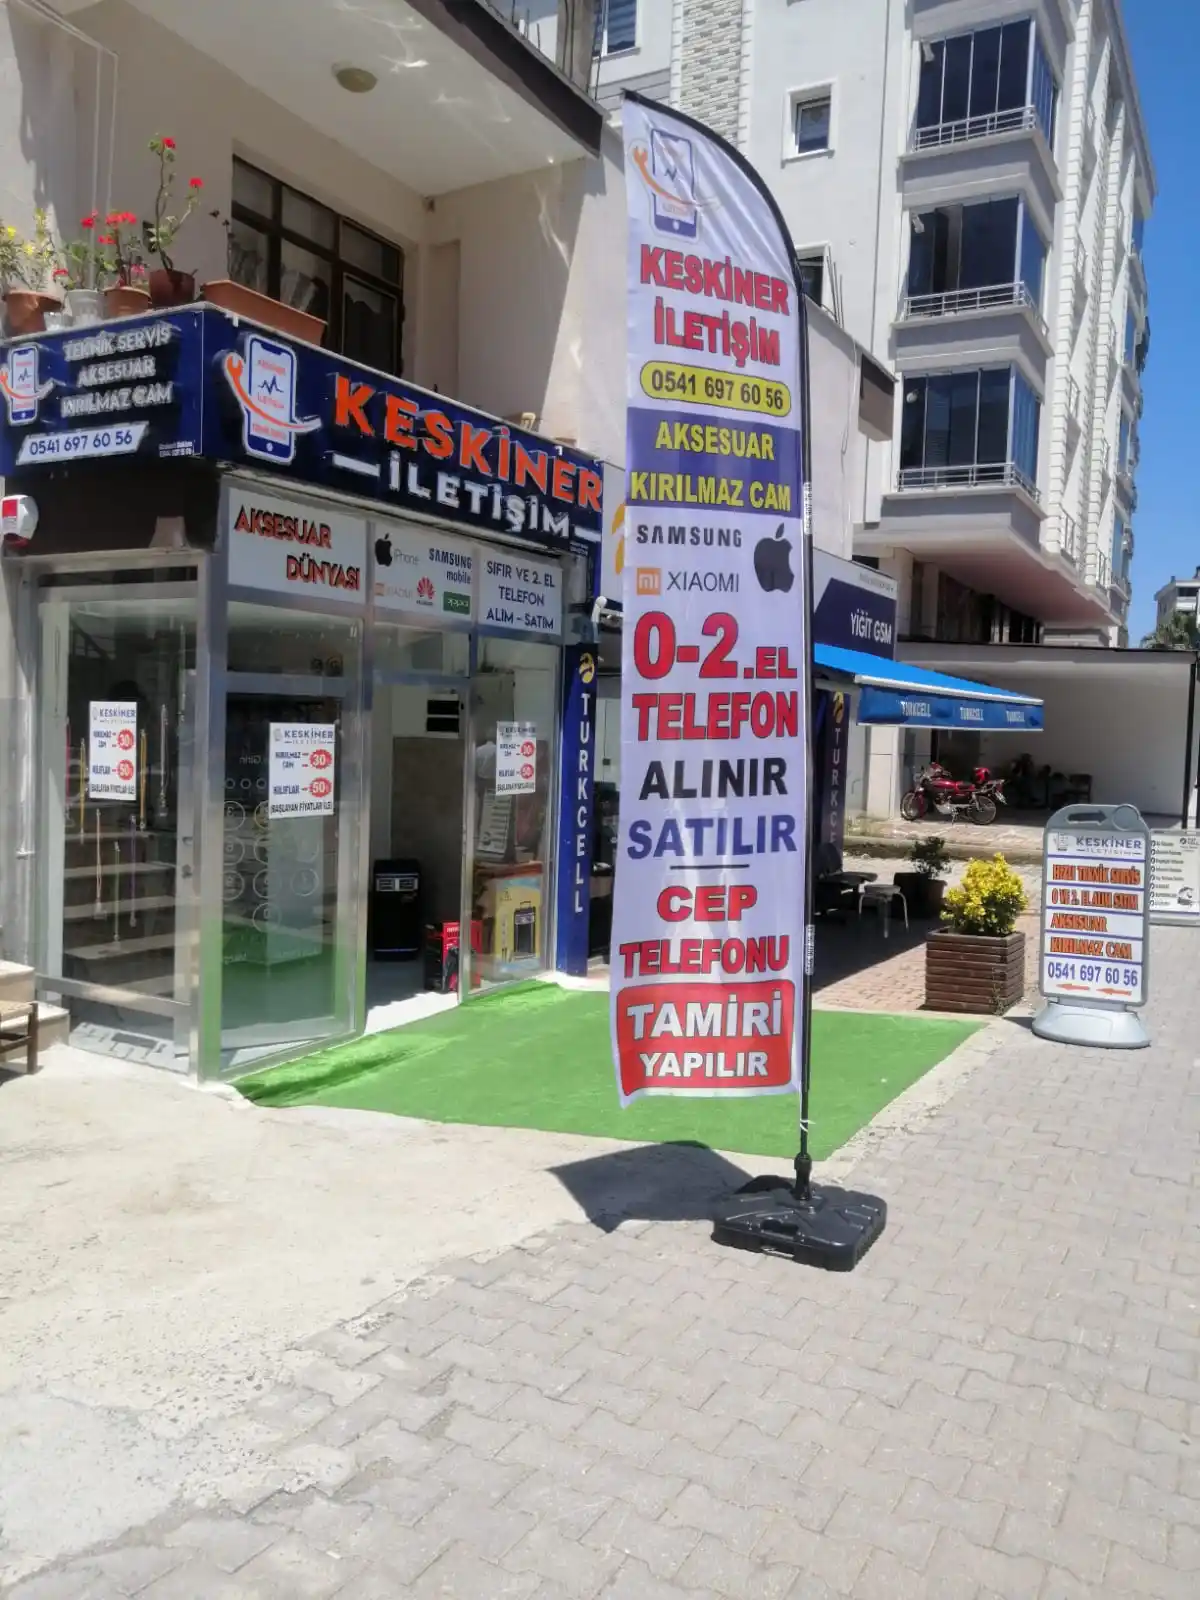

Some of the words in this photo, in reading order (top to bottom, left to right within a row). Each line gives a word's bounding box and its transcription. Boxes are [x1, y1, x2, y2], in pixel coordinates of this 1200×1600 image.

[640, 243, 790, 316] KESKİNER
[654, 295, 781, 368] İLETİŞİM
[77, 355, 156, 387] AKSESUAR
[651, 369, 696, 395] 0541
[704, 376, 735, 400] 697
[740, 383, 761, 405] 60
[766, 387, 784, 410] 56
[132, 381, 173, 408] CAM
[29, 439, 60, 455] 0541
[63, 435, 88, 451] 697
[93, 432, 111, 448] 60
[115, 430, 133, 445] 56
[333, 374, 602, 513] KESKİNER
[655, 420, 775, 460] AKSESUAR
[388, 450, 570, 539] İLETİŞİM
[630, 471, 745, 507] KIRILMAZ
[750, 481, 792, 512] CAM
[234, 505, 332, 549] AKSESUAR
[636, 524, 742, 548] SAMSUNG
[286, 552, 361, 591] DÜNYASI
[429, 548, 472, 569] SAMSUNG
[446, 570, 471, 584] mobile
[487, 560, 512, 579] SIFIR
[516, 567, 530, 582] VE
[544, 574, 556, 588] EL
[498, 585, 545, 607] TELEFON
[667, 571, 739, 592] XIAOMI
[486, 608, 514, 624] ALIM
[525, 614, 554, 629] SATIM
[850, 608, 873, 637] YİĞİT
[873, 620, 892, 644] GSM
[632, 691, 798, 741] TELEFON
[639, 757, 788, 801] ALINIR
[829, 728, 842, 843] TURKCE
[574, 692, 591, 913] TURKCELL
[627, 814, 798, 860] SATILIR
[1076, 835, 1142, 849] KESKİNER
[656, 884, 758, 922] CEP
[1050, 912, 1108, 932] AKSESUAR
[619, 935, 789, 978] TELEFONU
[1050, 936, 1104, 956] KIRILMAZ
[1105, 942, 1132, 960] CAM
[1047, 962, 1075, 980] 0541
[1080, 964, 1102, 983] 697
[1105, 967, 1119, 984] 60
[1123, 969, 1138, 986] 56
[627, 990, 783, 1040] TAMİRİ
[640, 1052, 769, 1078] YAPILIR
